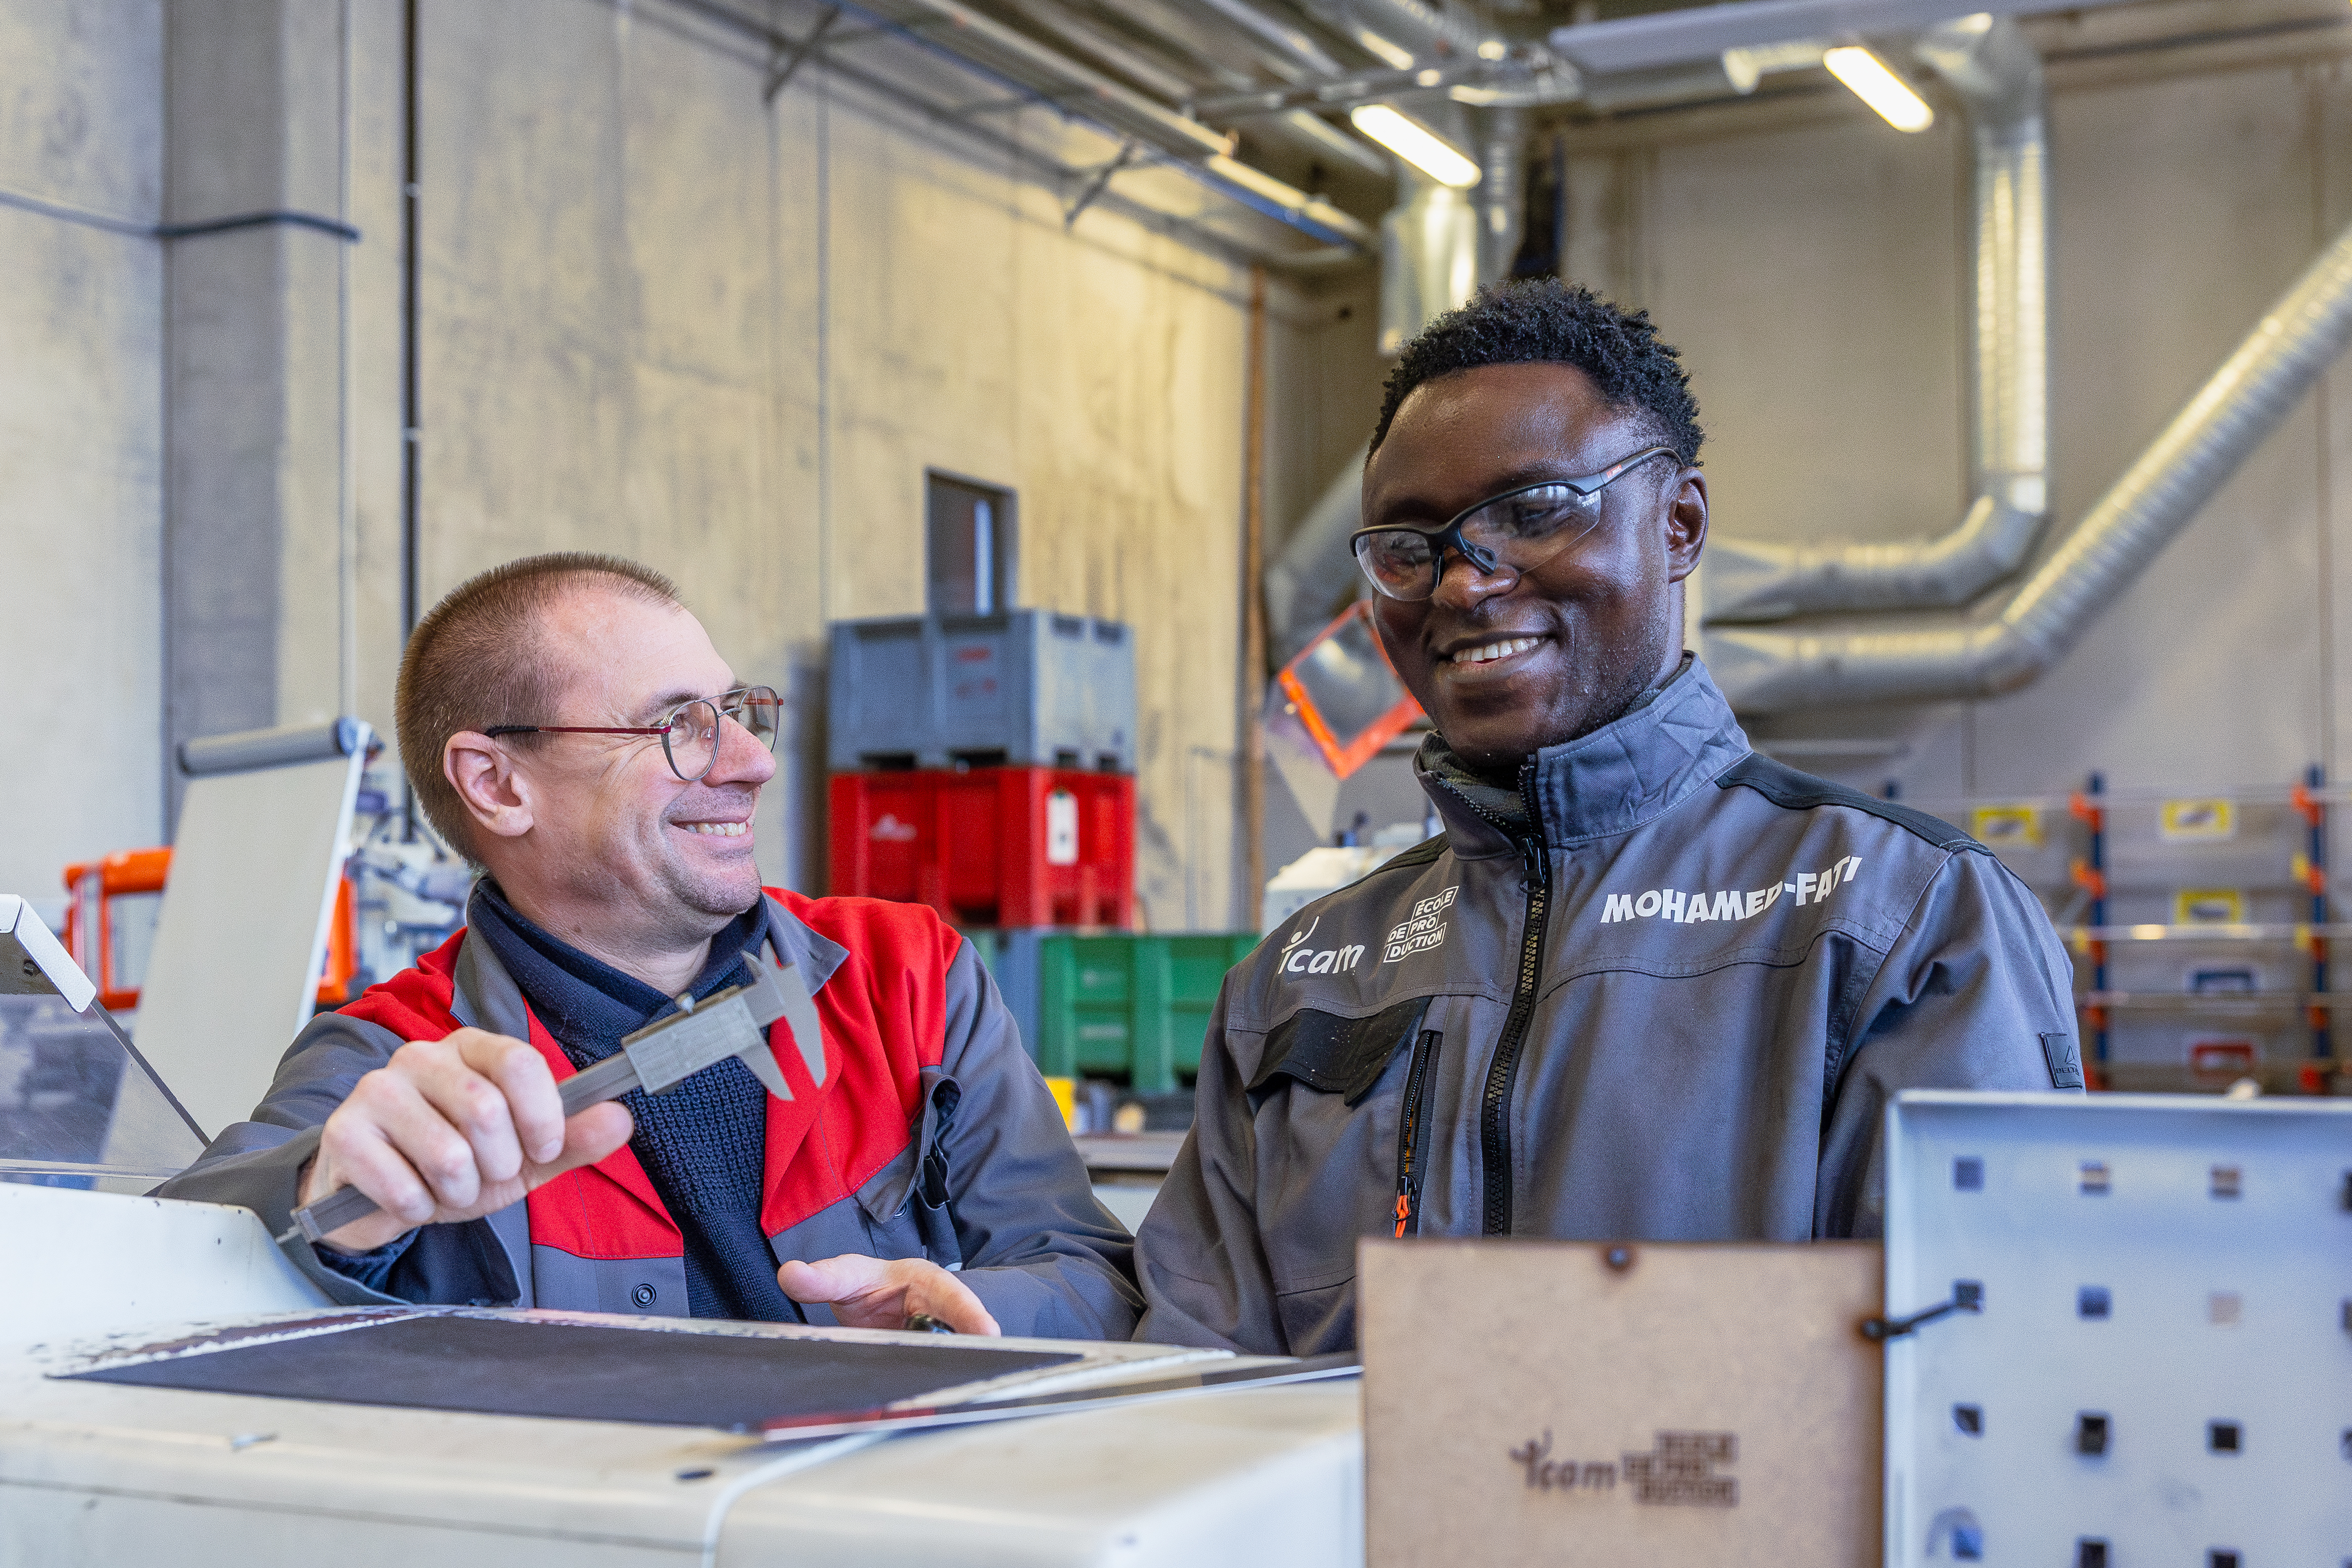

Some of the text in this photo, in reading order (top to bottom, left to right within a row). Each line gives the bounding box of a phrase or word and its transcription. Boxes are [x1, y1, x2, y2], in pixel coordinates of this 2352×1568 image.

[1416, 890, 1453, 917] ÉCOLE
[1600, 856, 1863, 924] MOHAMED-FATI
[1387, 927, 1407, 943] DE
[1390, 928, 1443, 958] DUCTION
